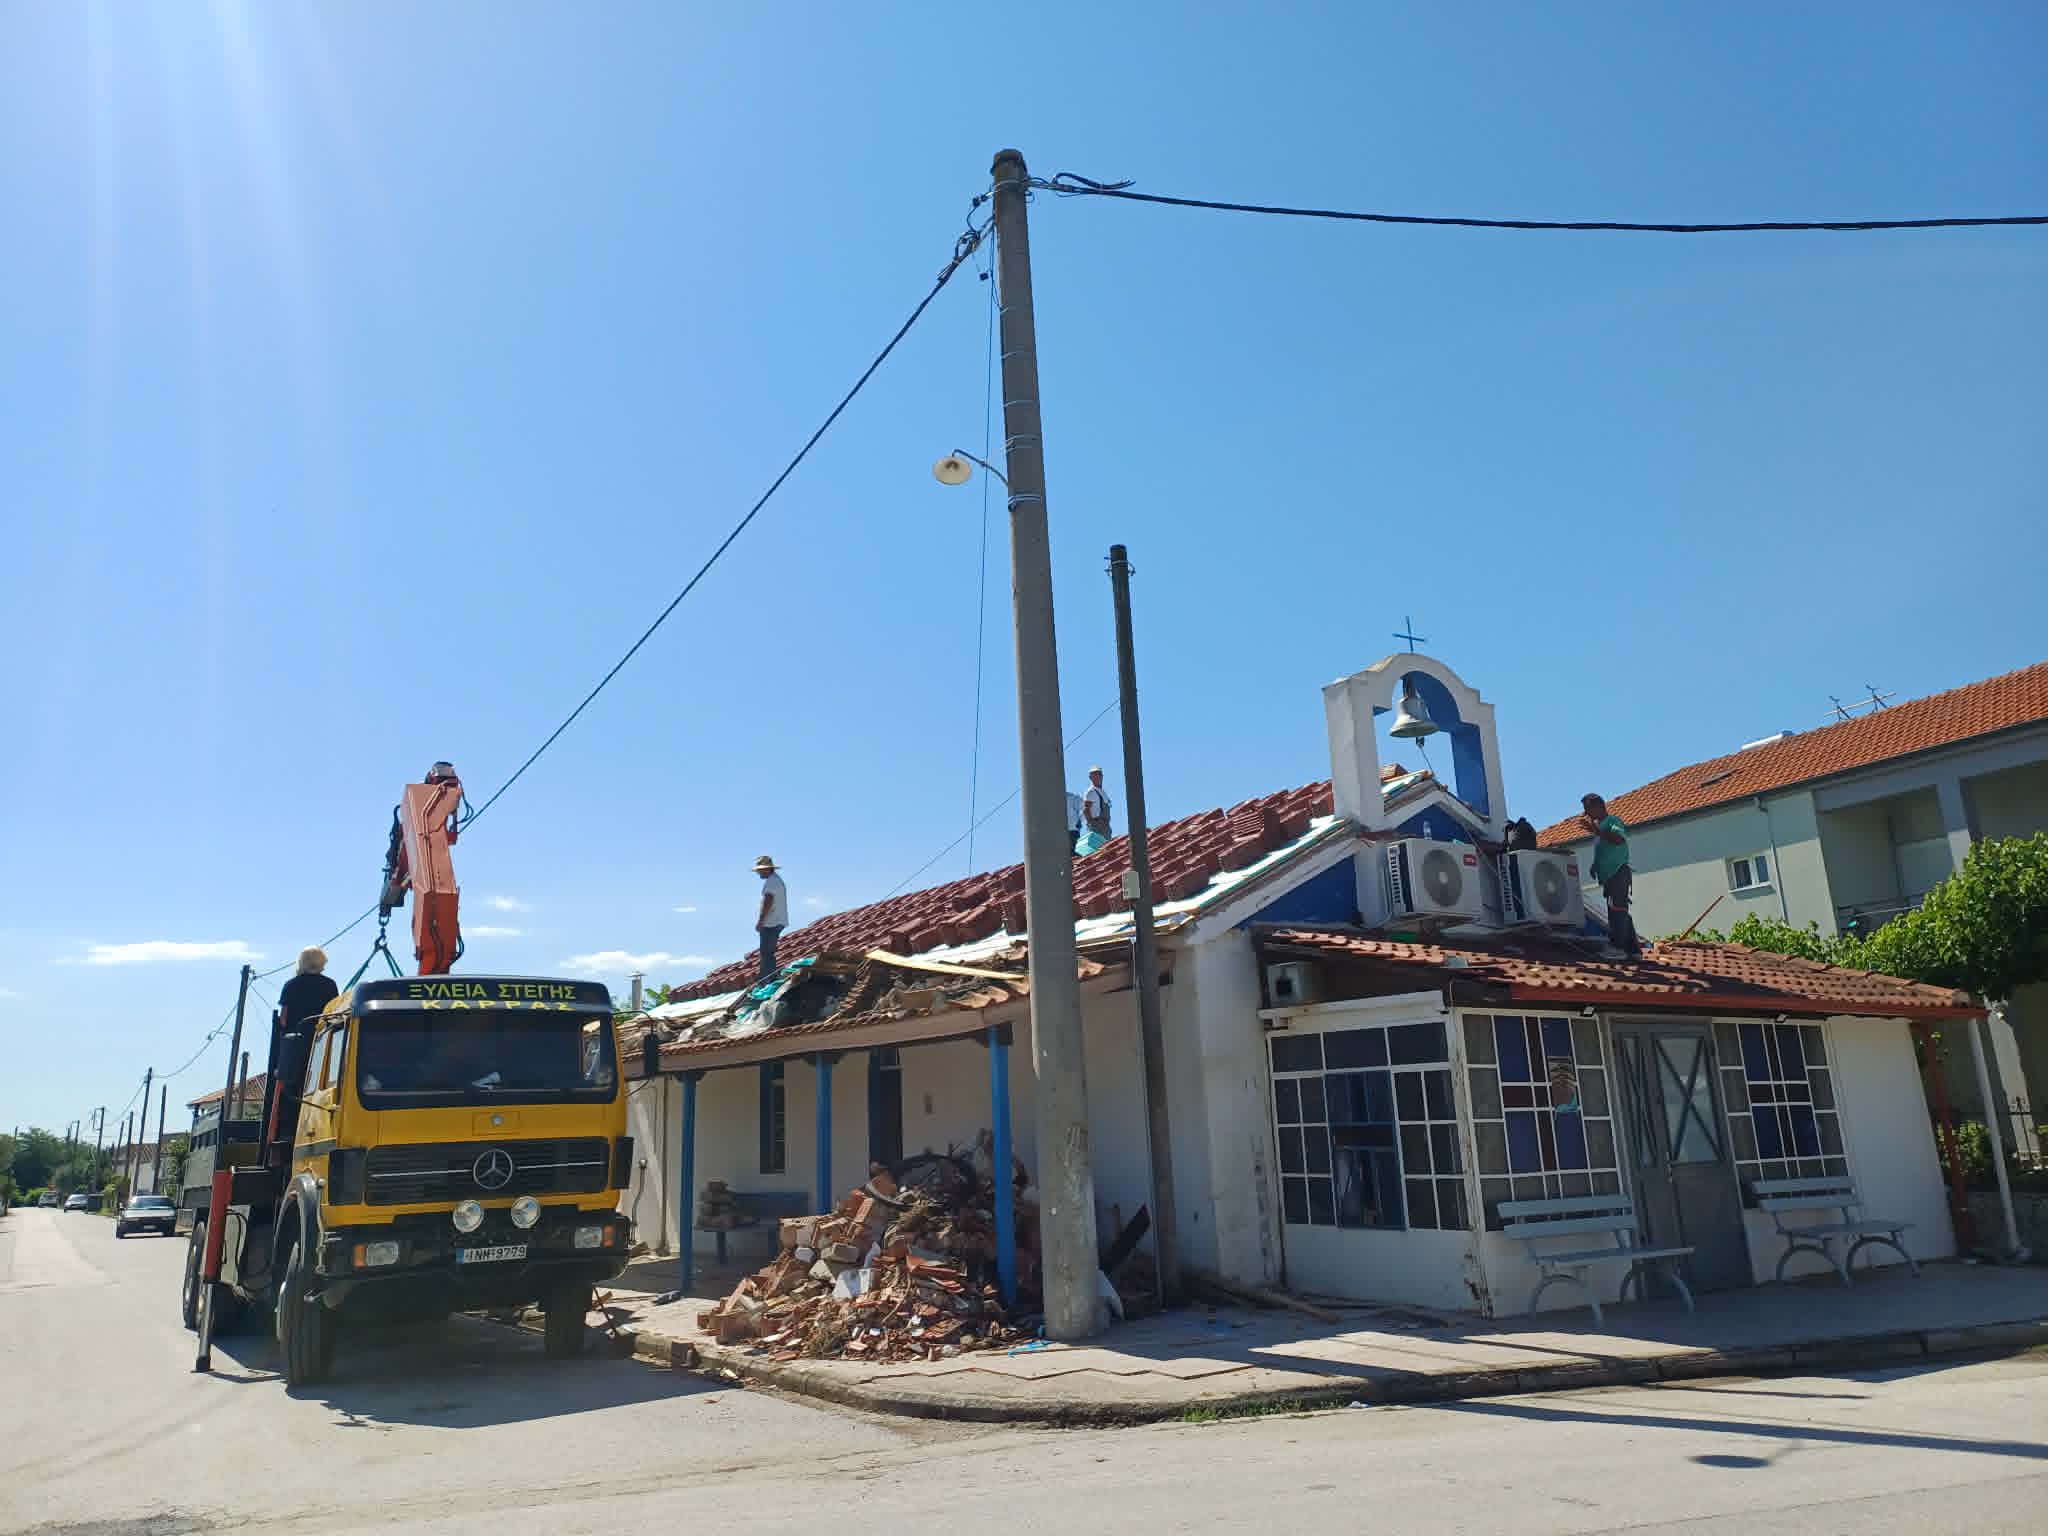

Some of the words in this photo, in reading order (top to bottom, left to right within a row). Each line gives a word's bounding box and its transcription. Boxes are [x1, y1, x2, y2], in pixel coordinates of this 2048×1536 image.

[408, 983, 487, 998] ΞΥΛΕΙΑ
[497, 984, 577, 999] ΣΤΕΓΗΣ
[421, 1000, 577, 1011] ΚΑΡΡΑΣ
